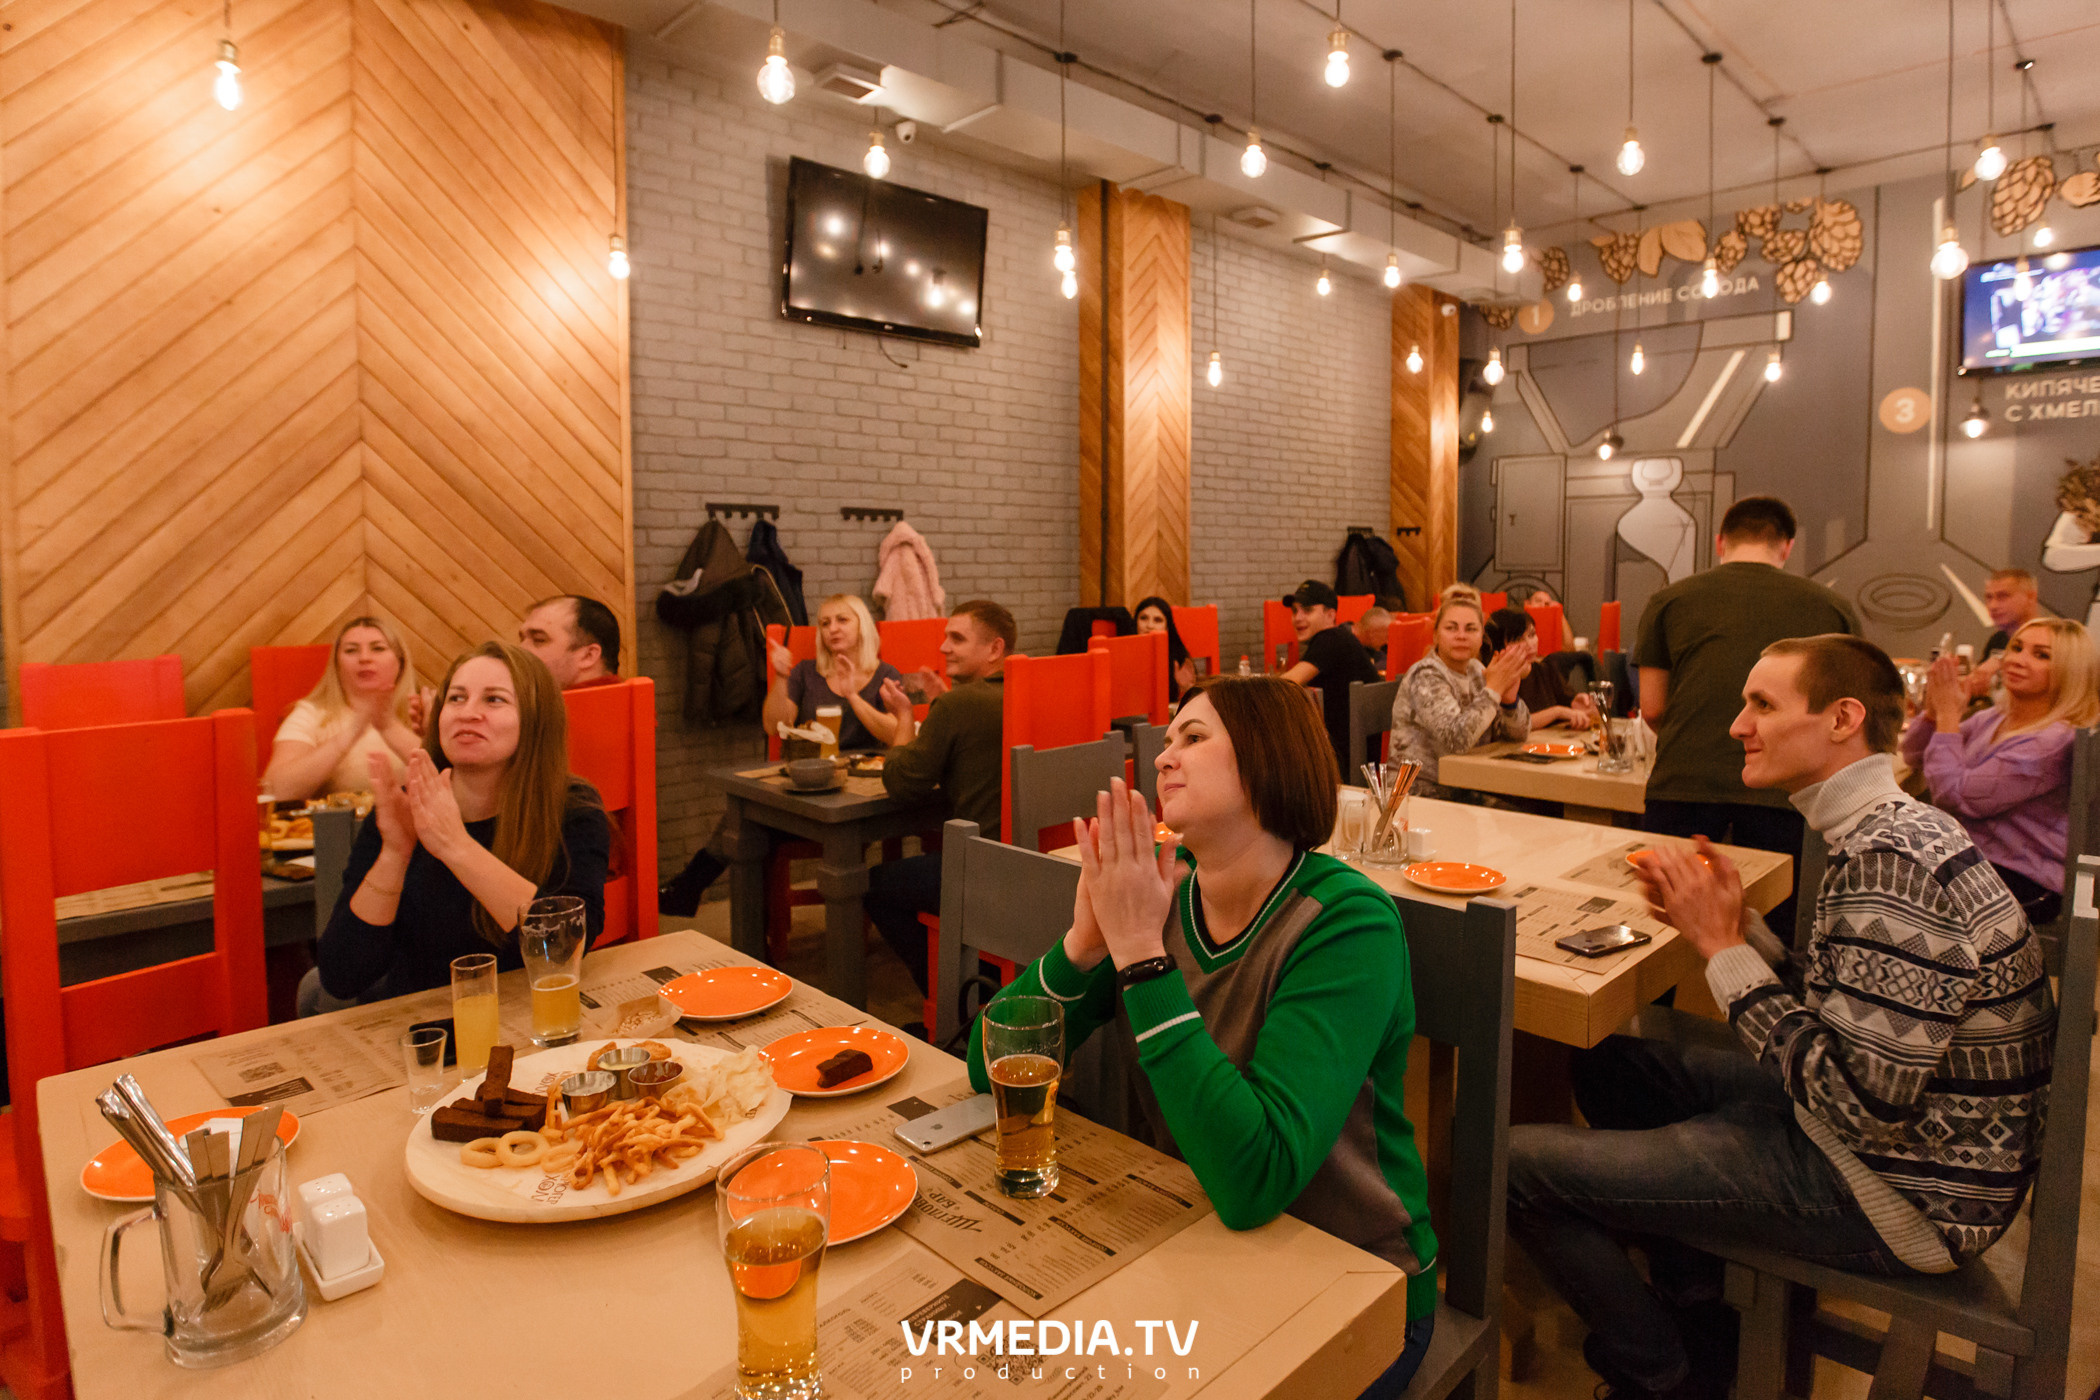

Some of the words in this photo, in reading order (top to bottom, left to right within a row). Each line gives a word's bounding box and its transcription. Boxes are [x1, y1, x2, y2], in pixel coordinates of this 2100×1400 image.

[1676, 277, 1759, 302] СООДА
[1532, 305, 1540, 326] 1
[1895, 398, 1915, 423] 3
[2005, 405, 2022, 422] С
